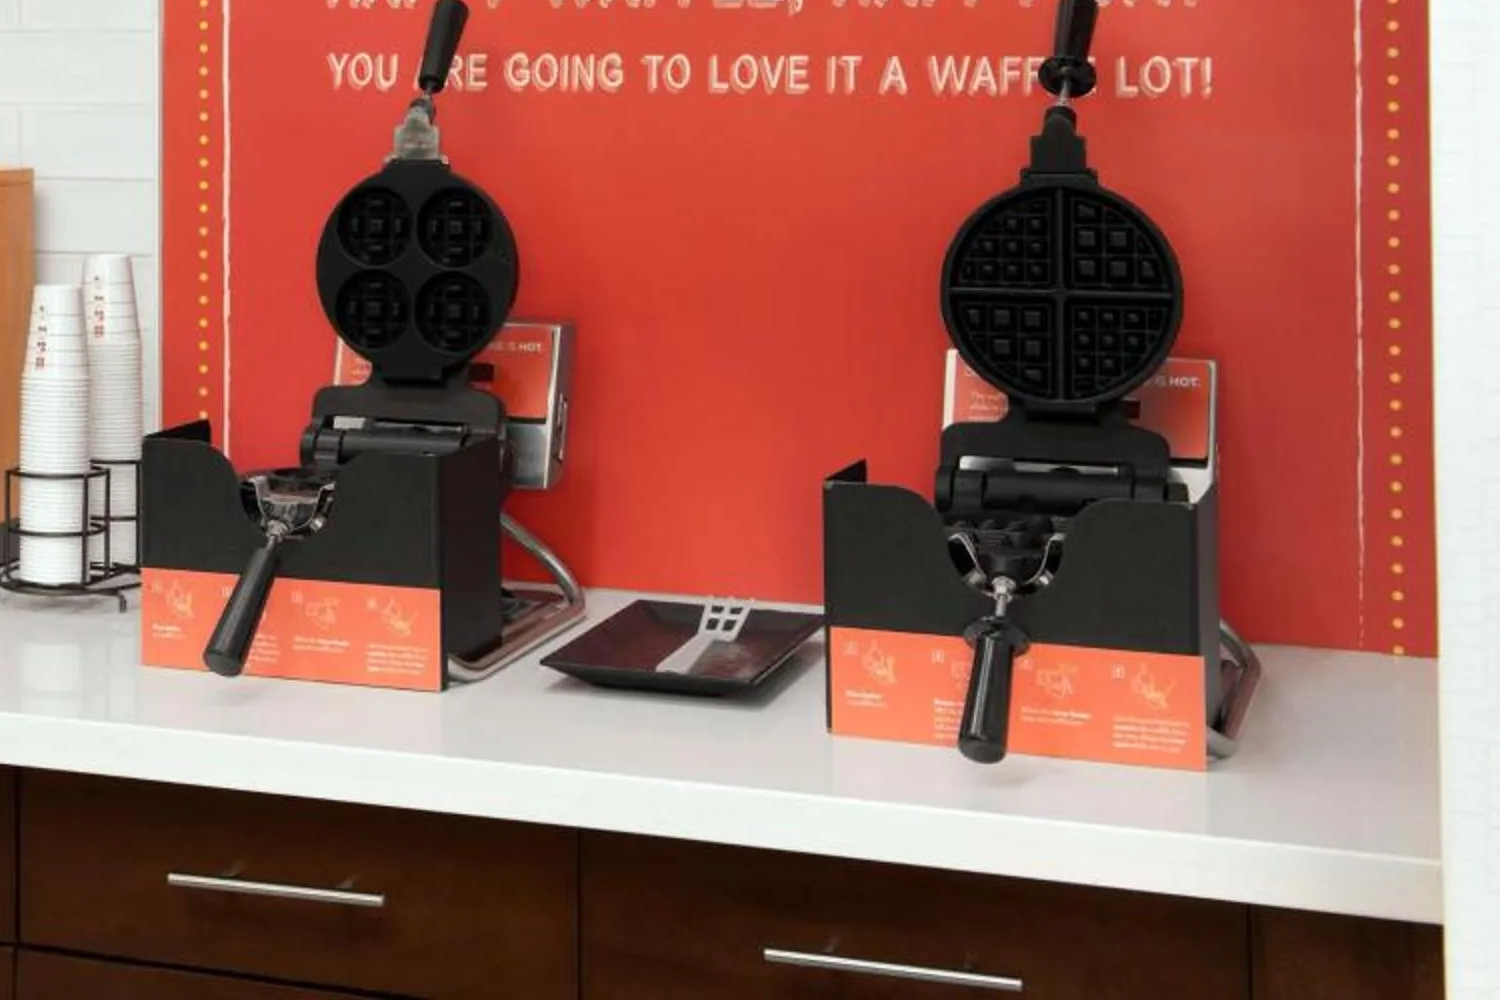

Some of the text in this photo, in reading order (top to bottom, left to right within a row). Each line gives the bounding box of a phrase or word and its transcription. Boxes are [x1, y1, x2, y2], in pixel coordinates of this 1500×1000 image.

[326, 52, 1212, 97] YOU RE GOING TO LOVE IT A WAFF LOT!
